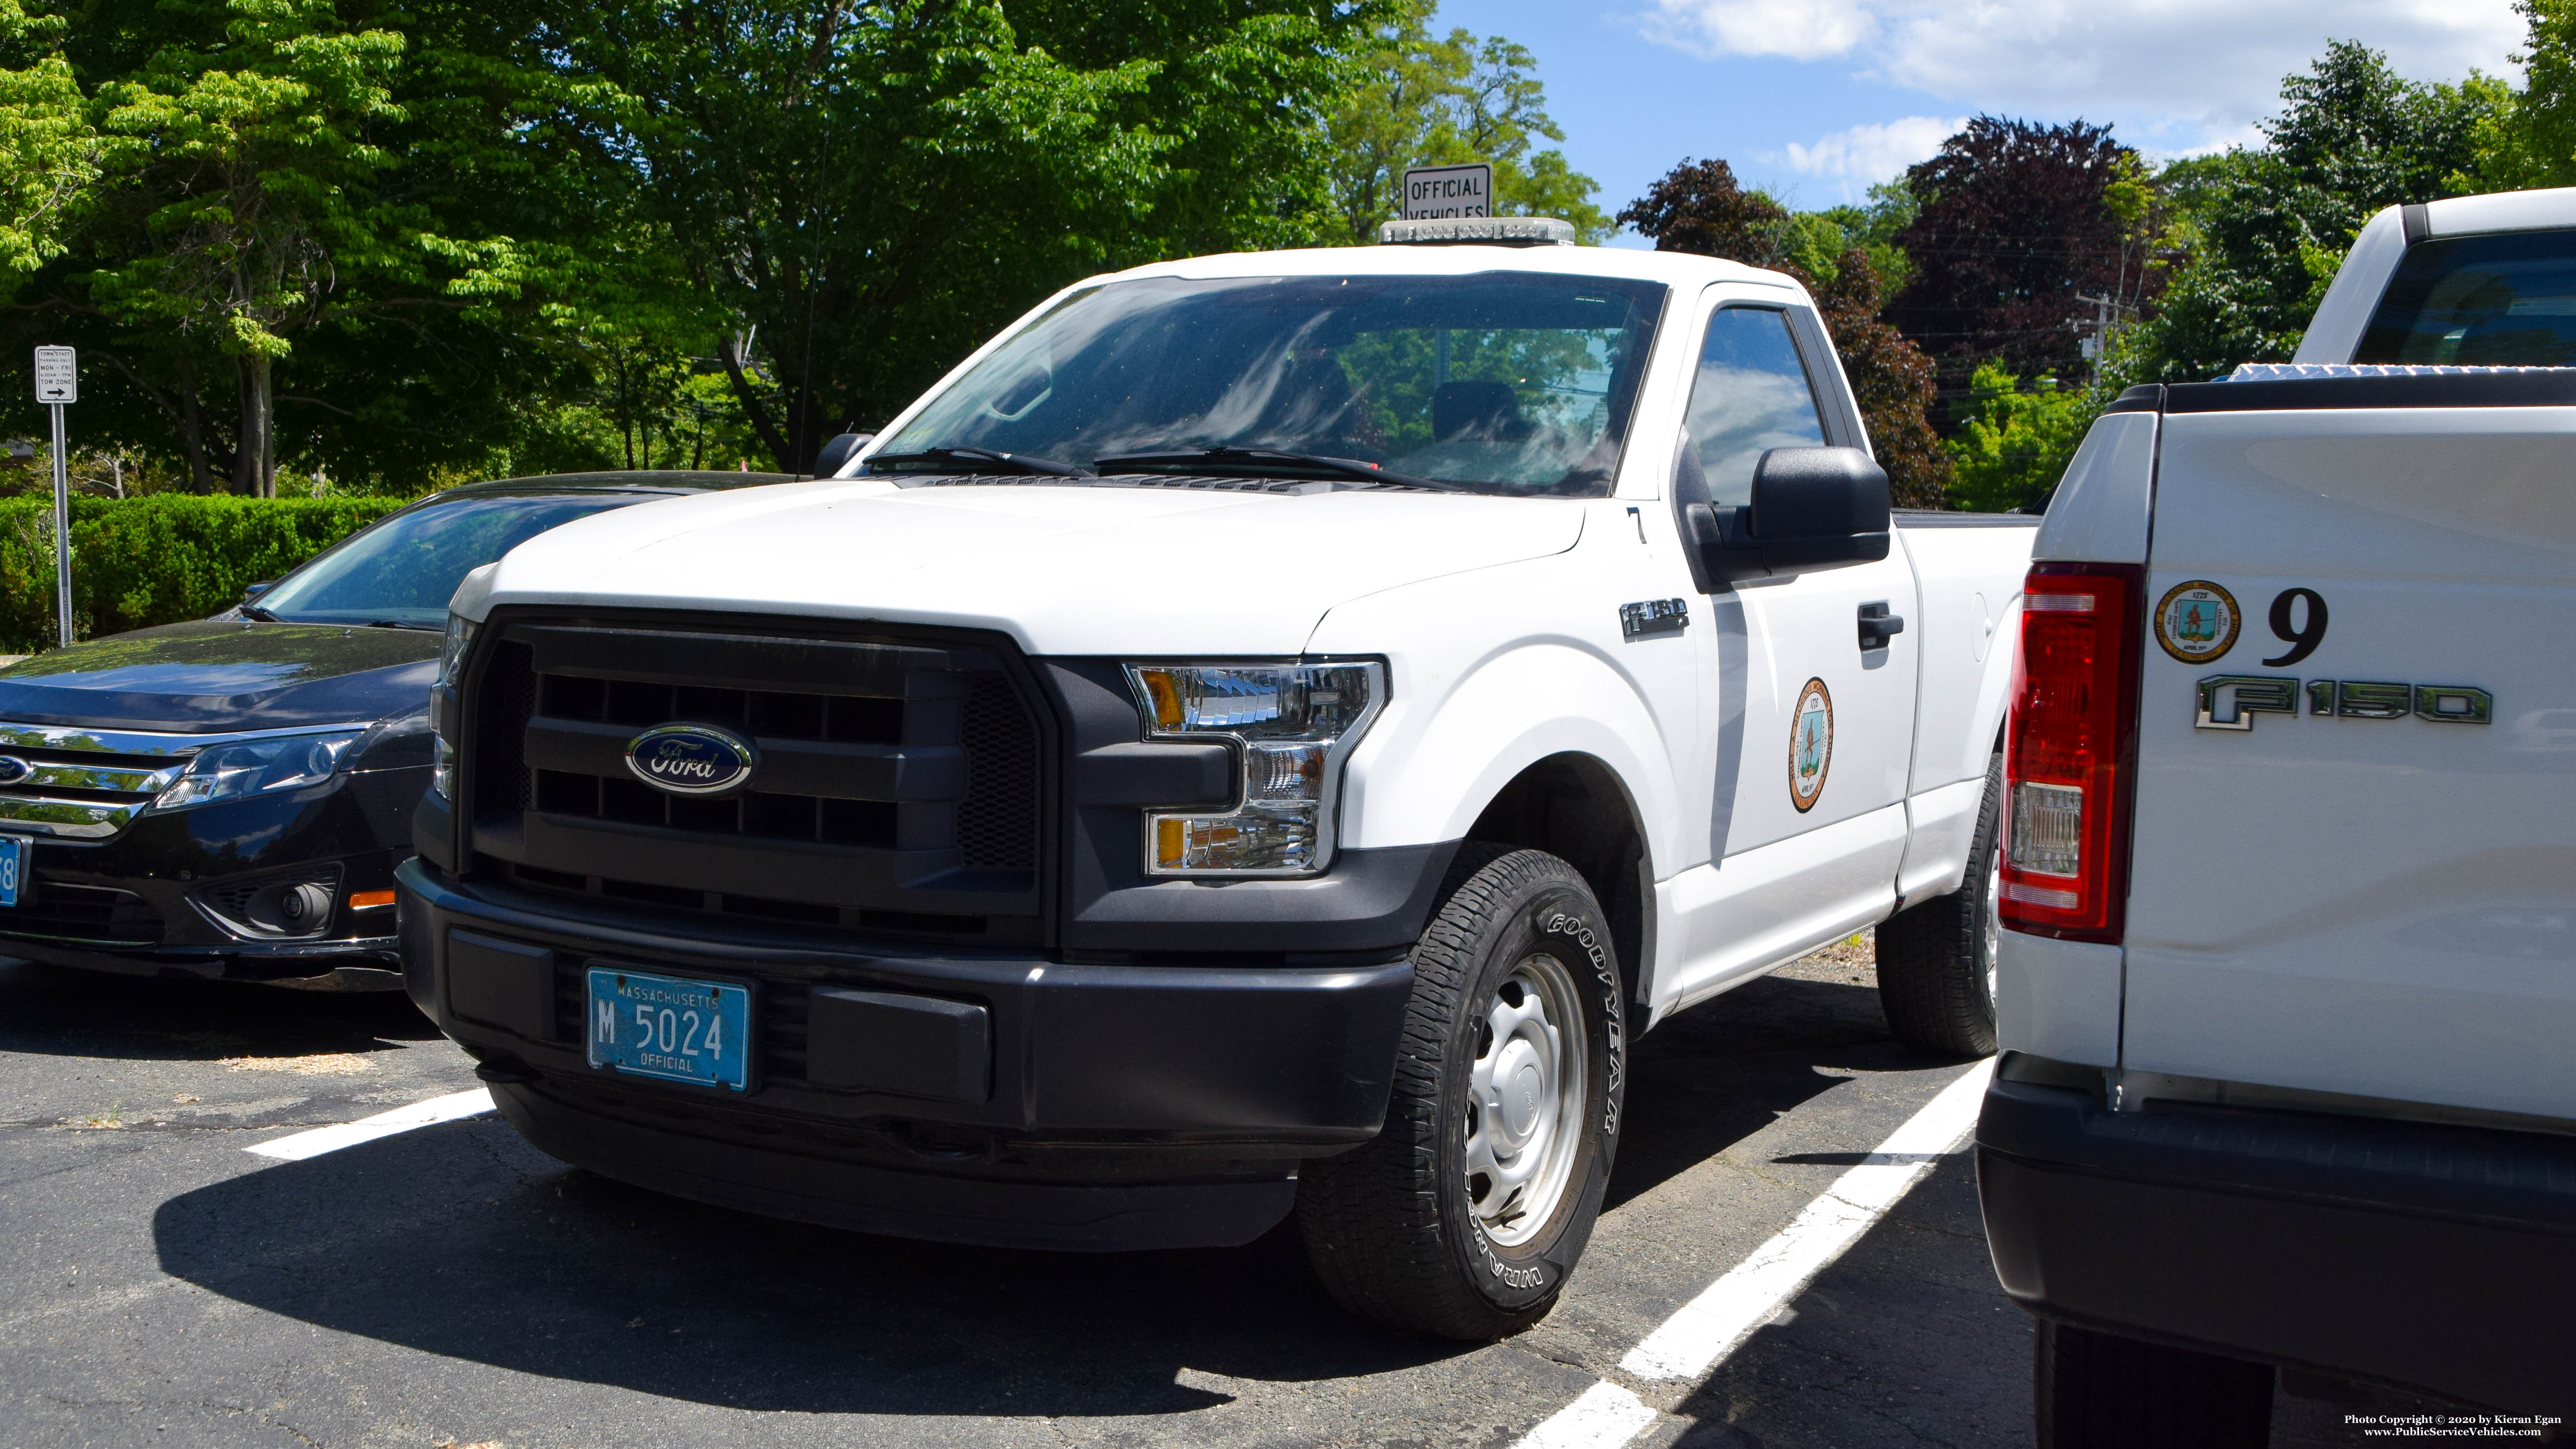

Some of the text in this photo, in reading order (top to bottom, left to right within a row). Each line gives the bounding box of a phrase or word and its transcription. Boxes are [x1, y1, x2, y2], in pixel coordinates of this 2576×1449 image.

[1412, 178, 1481, 200] OFFICIAL
[2262, 588, 2328, 667] 9
[1810, 697, 1819, 710] 1775
[2194, 674, 2493, 731] F150
[651, 739, 718, 777] Ford
[617, 987, 719, 1009] MASSACHUSETTS
[598, 999, 721, 1060] M 5024
[1547, 913, 1621, 1136] GOODYEAR
[641, 1054, 693, 1072] OFFICIAL
